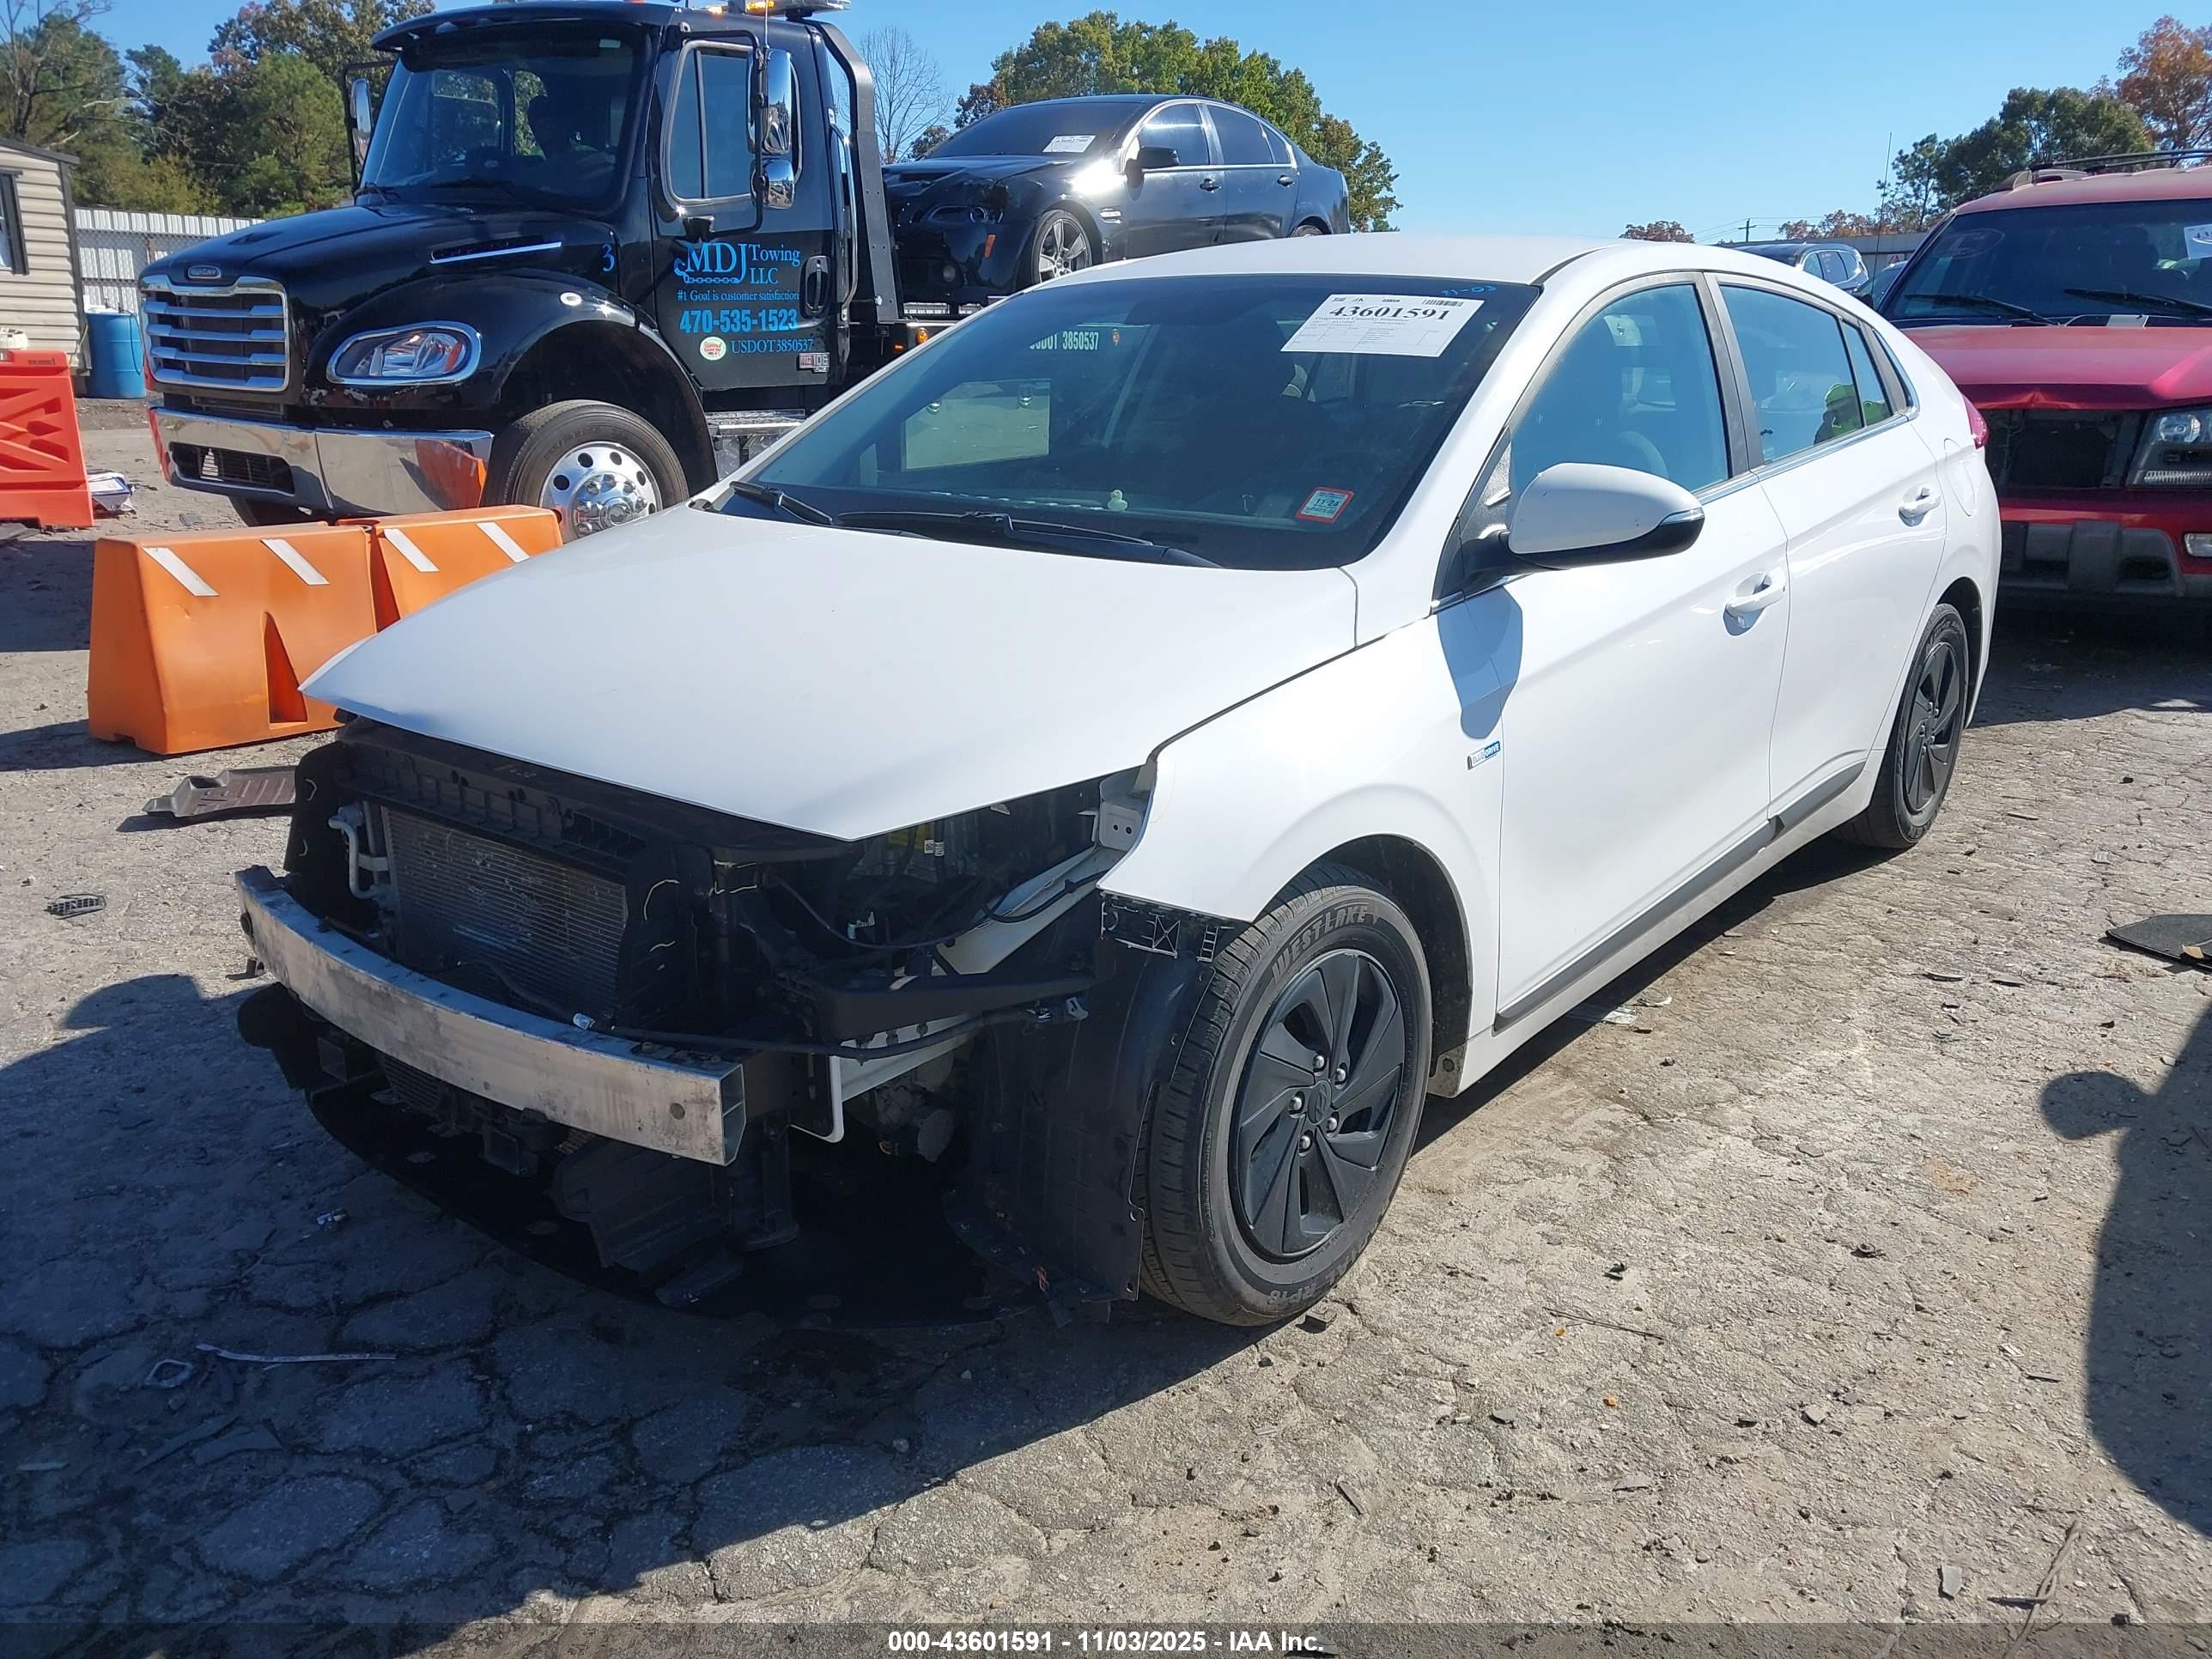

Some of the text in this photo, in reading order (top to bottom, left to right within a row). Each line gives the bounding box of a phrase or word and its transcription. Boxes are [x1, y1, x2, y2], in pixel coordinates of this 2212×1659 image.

[602, 243, 615, 271] 3
[684, 242, 800, 283] MDJ Towing
[749, 267, 779, 284] LLC
[677, 289, 799, 301] #1 Goal is customer satisfaction
[679, 308, 798, 333] 470-535-1523
[1329, 306, 1451, 320] 43601591
[731, 339, 775, 354] USDOT
[775, 338, 814, 352] 3850537
[1062, 331, 1099, 350] 3850537
[1271, 905, 1369, 981] WESTLAKE
